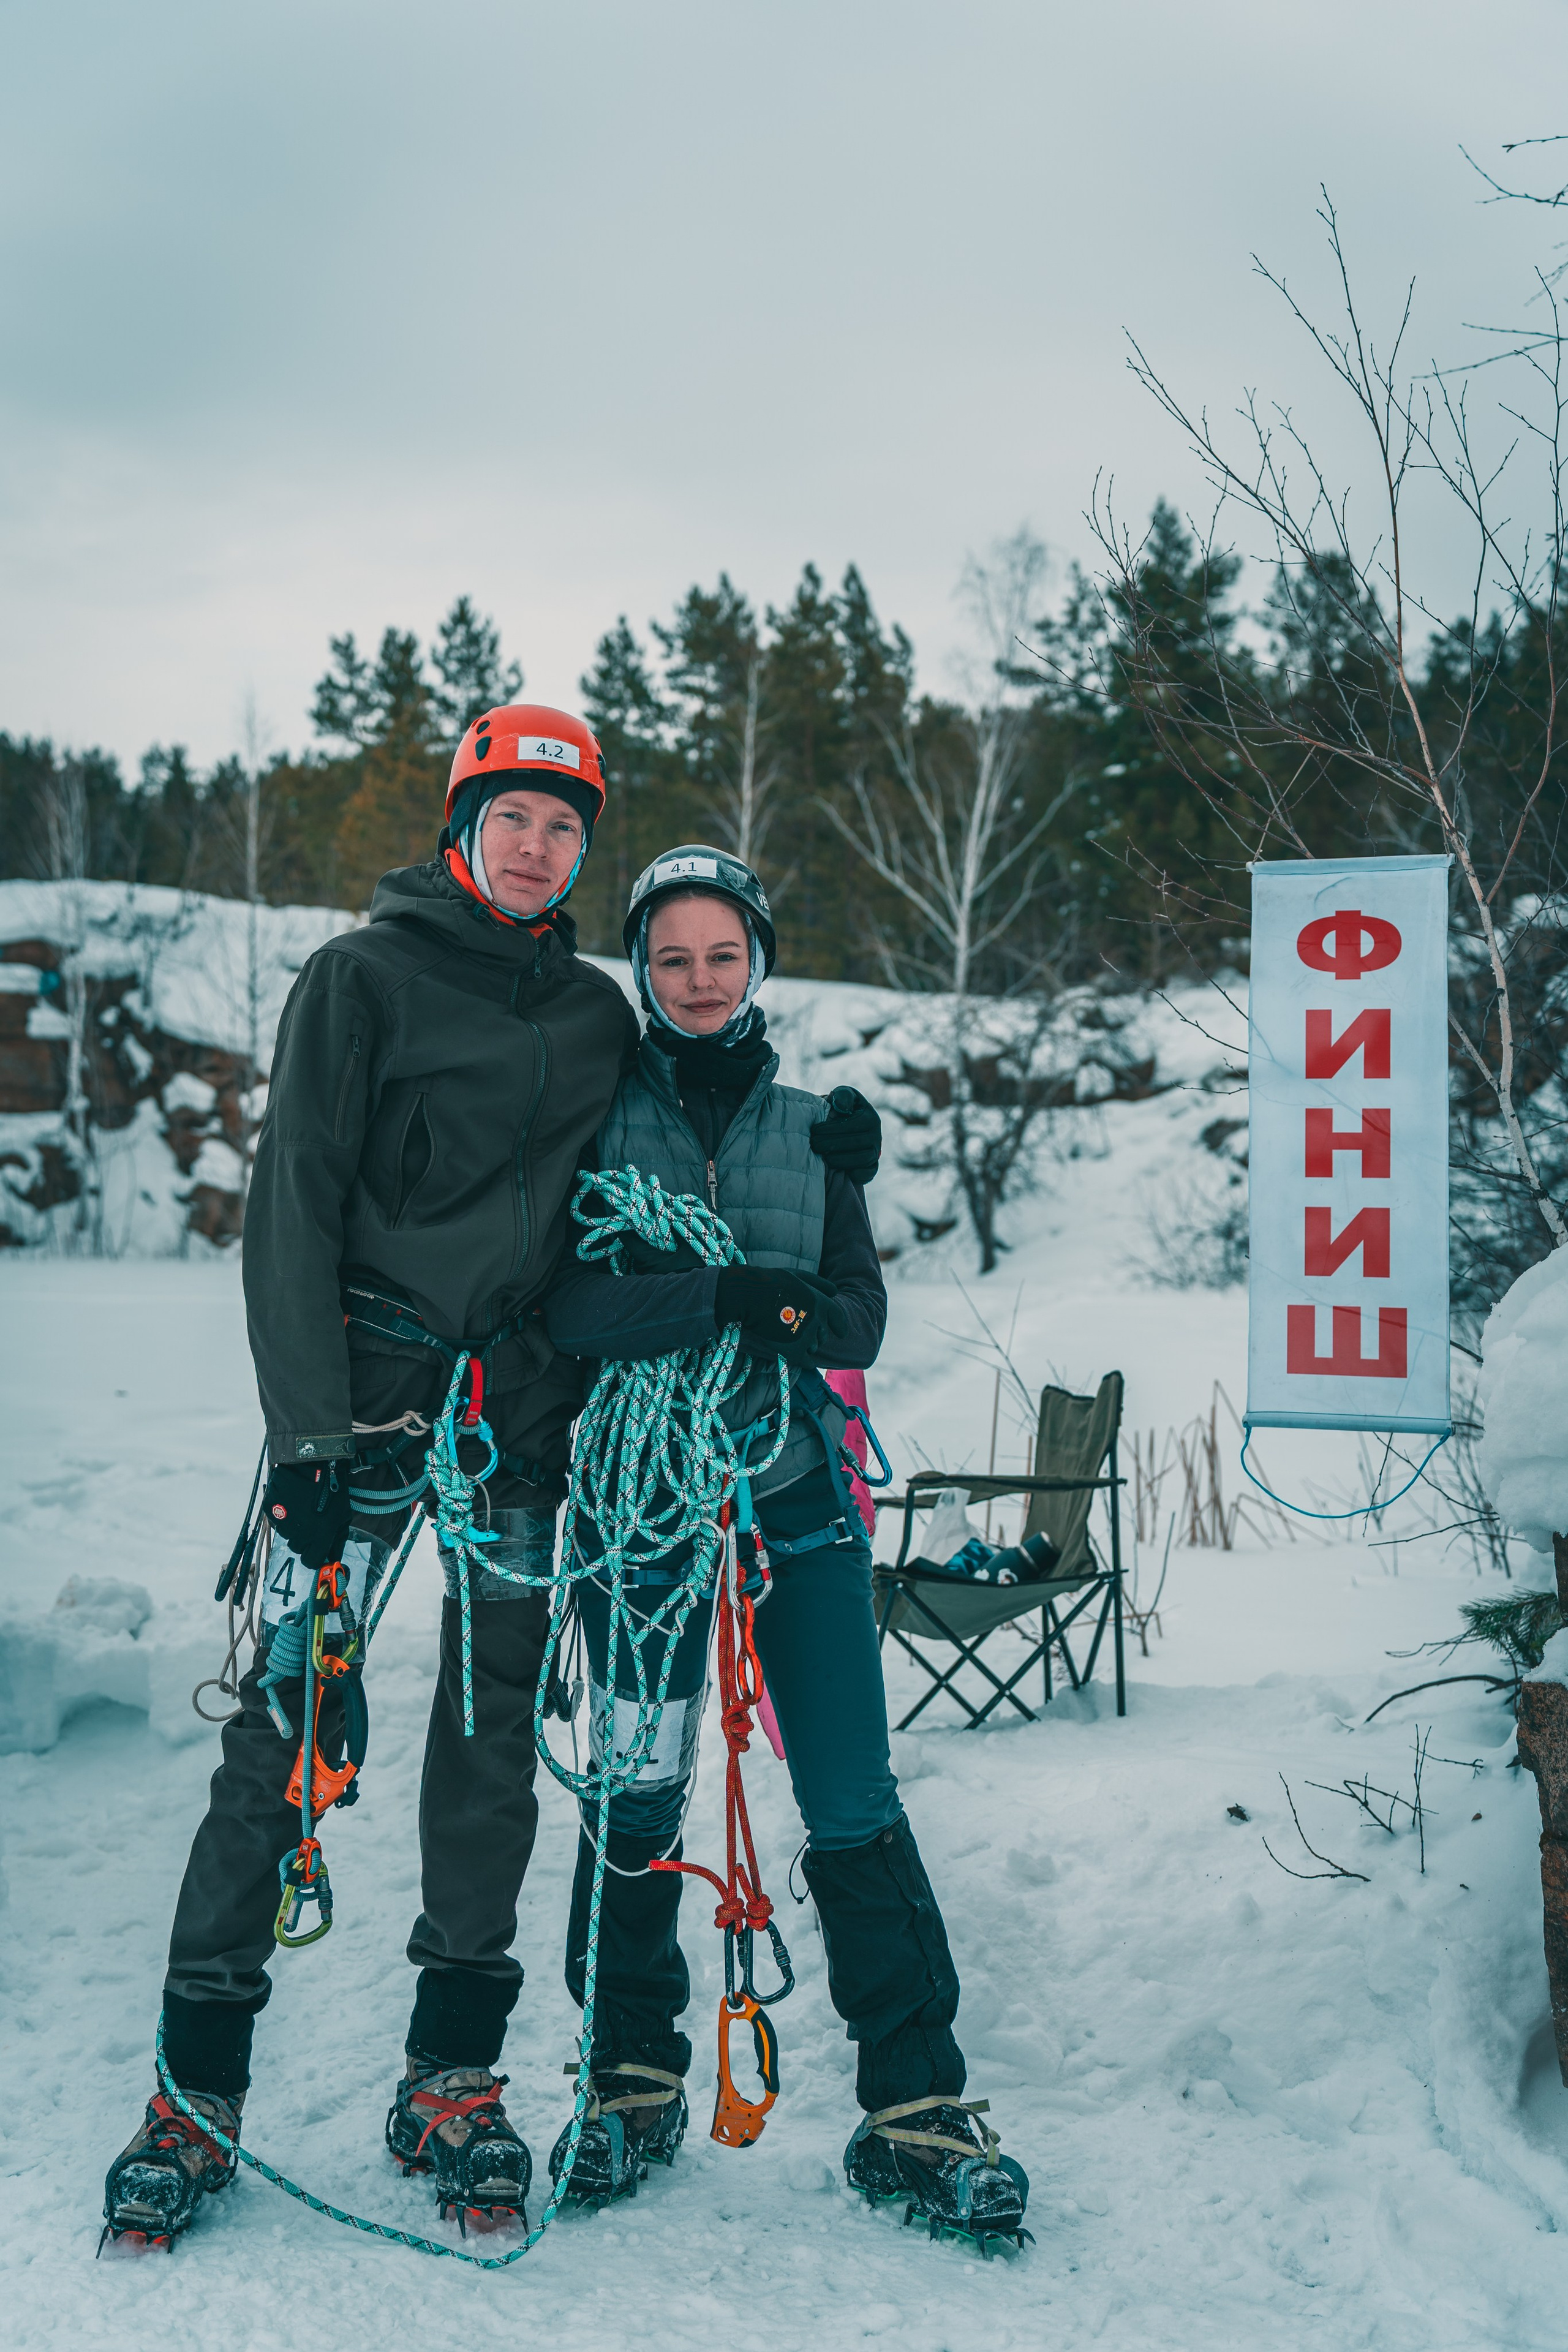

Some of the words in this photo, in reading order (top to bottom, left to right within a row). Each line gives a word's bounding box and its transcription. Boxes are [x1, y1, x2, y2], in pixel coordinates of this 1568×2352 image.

[537, 743, 564, 759] 4.2
[671, 862, 697, 873] 4.1
[1287, 910, 1408, 1378] ФИНИШ
[270, 1557, 295, 1607] 4
